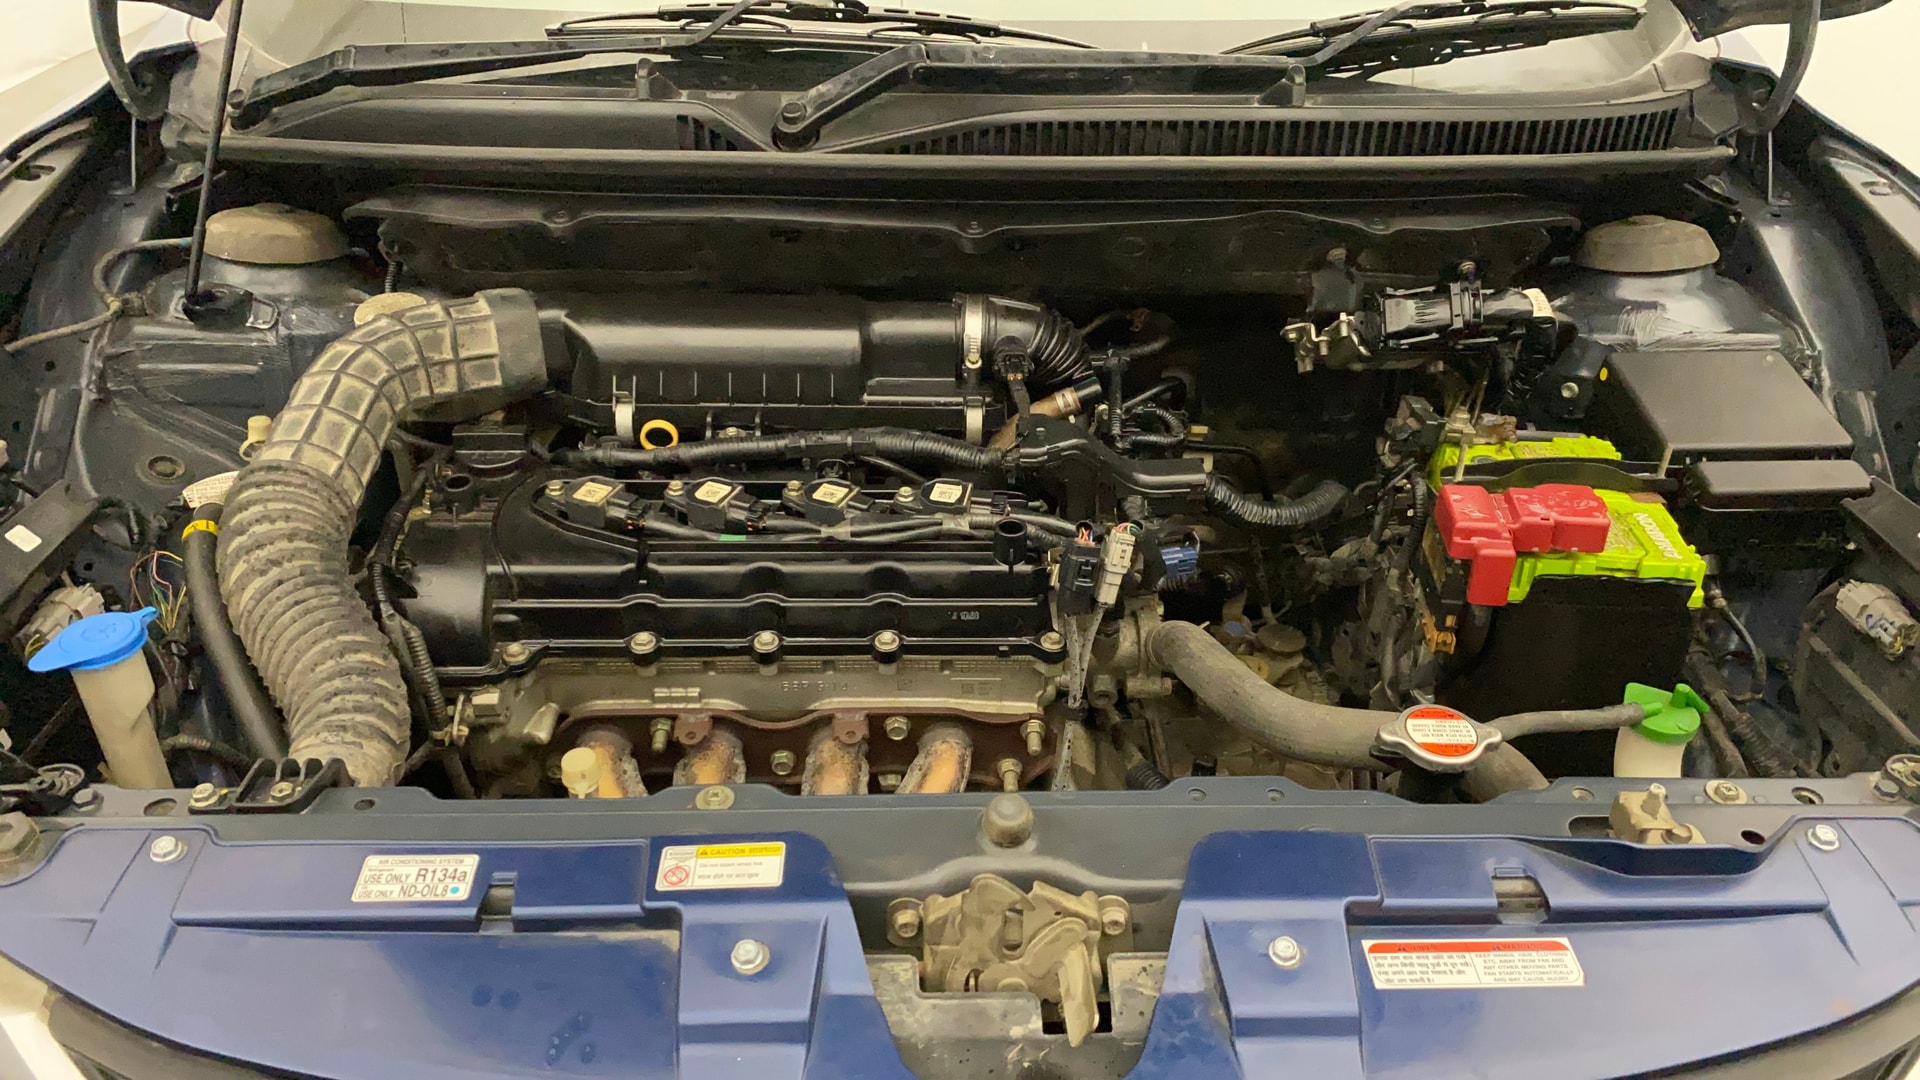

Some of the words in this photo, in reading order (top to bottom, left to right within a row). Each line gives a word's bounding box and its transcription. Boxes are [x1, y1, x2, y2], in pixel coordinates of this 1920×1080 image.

[709, 847, 746, 856] CAUTION
[363, 873, 384, 884] USE
[385, 873, 411, 884] ONLY
[415, 867, 468, 882] R134a
[358, 889, 373, 898] USE
[374, 889, 394, 898] ONLY
[398, 885, 449, 897] ND-OIL8
